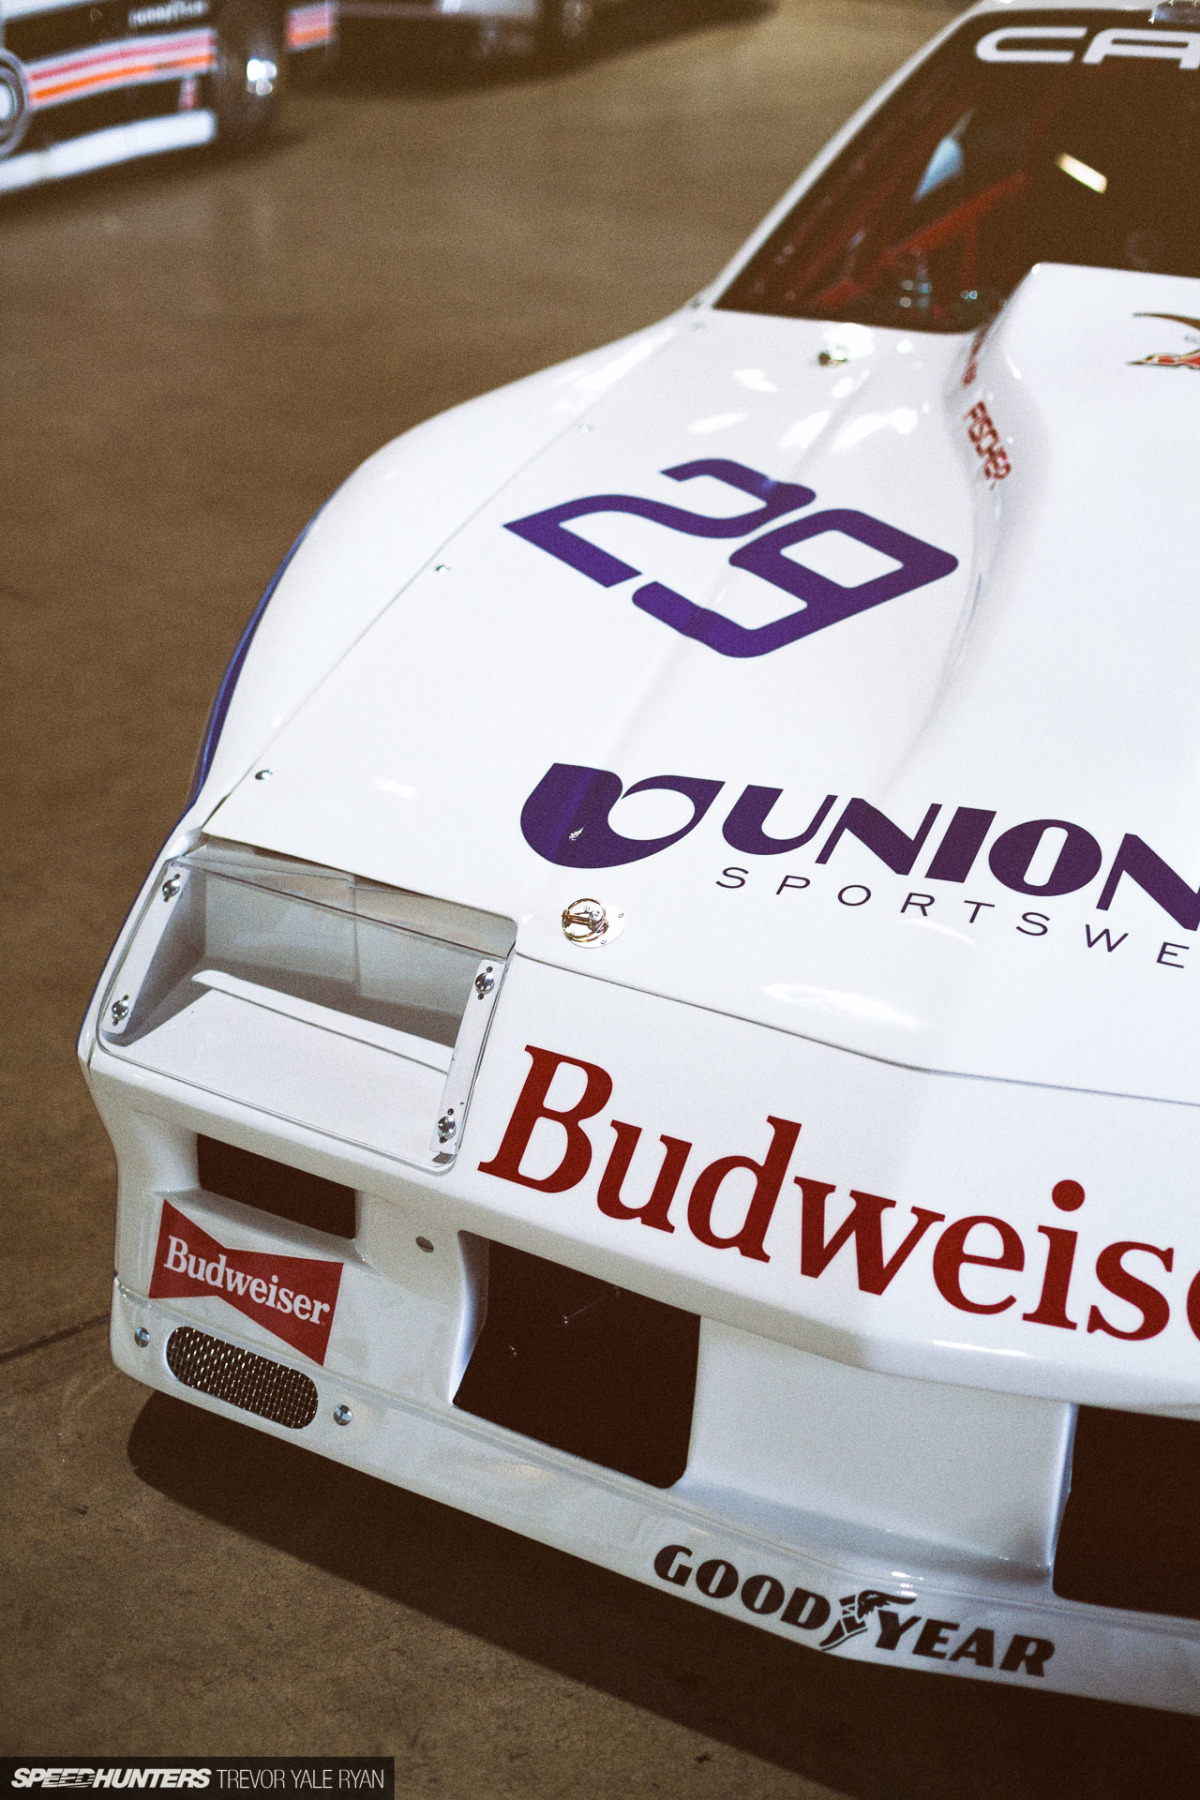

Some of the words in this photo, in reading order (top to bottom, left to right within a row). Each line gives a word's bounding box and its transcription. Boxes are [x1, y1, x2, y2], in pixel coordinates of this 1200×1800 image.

[502, 458, 959, 658] 29
[715, 866, 1190, 969] SPORTSWE
[722, 784, 1200, 931] UNION
[477, 1044, 1200, 1341] Budweis
[163, 1235, 330, 1325] Budweiser
